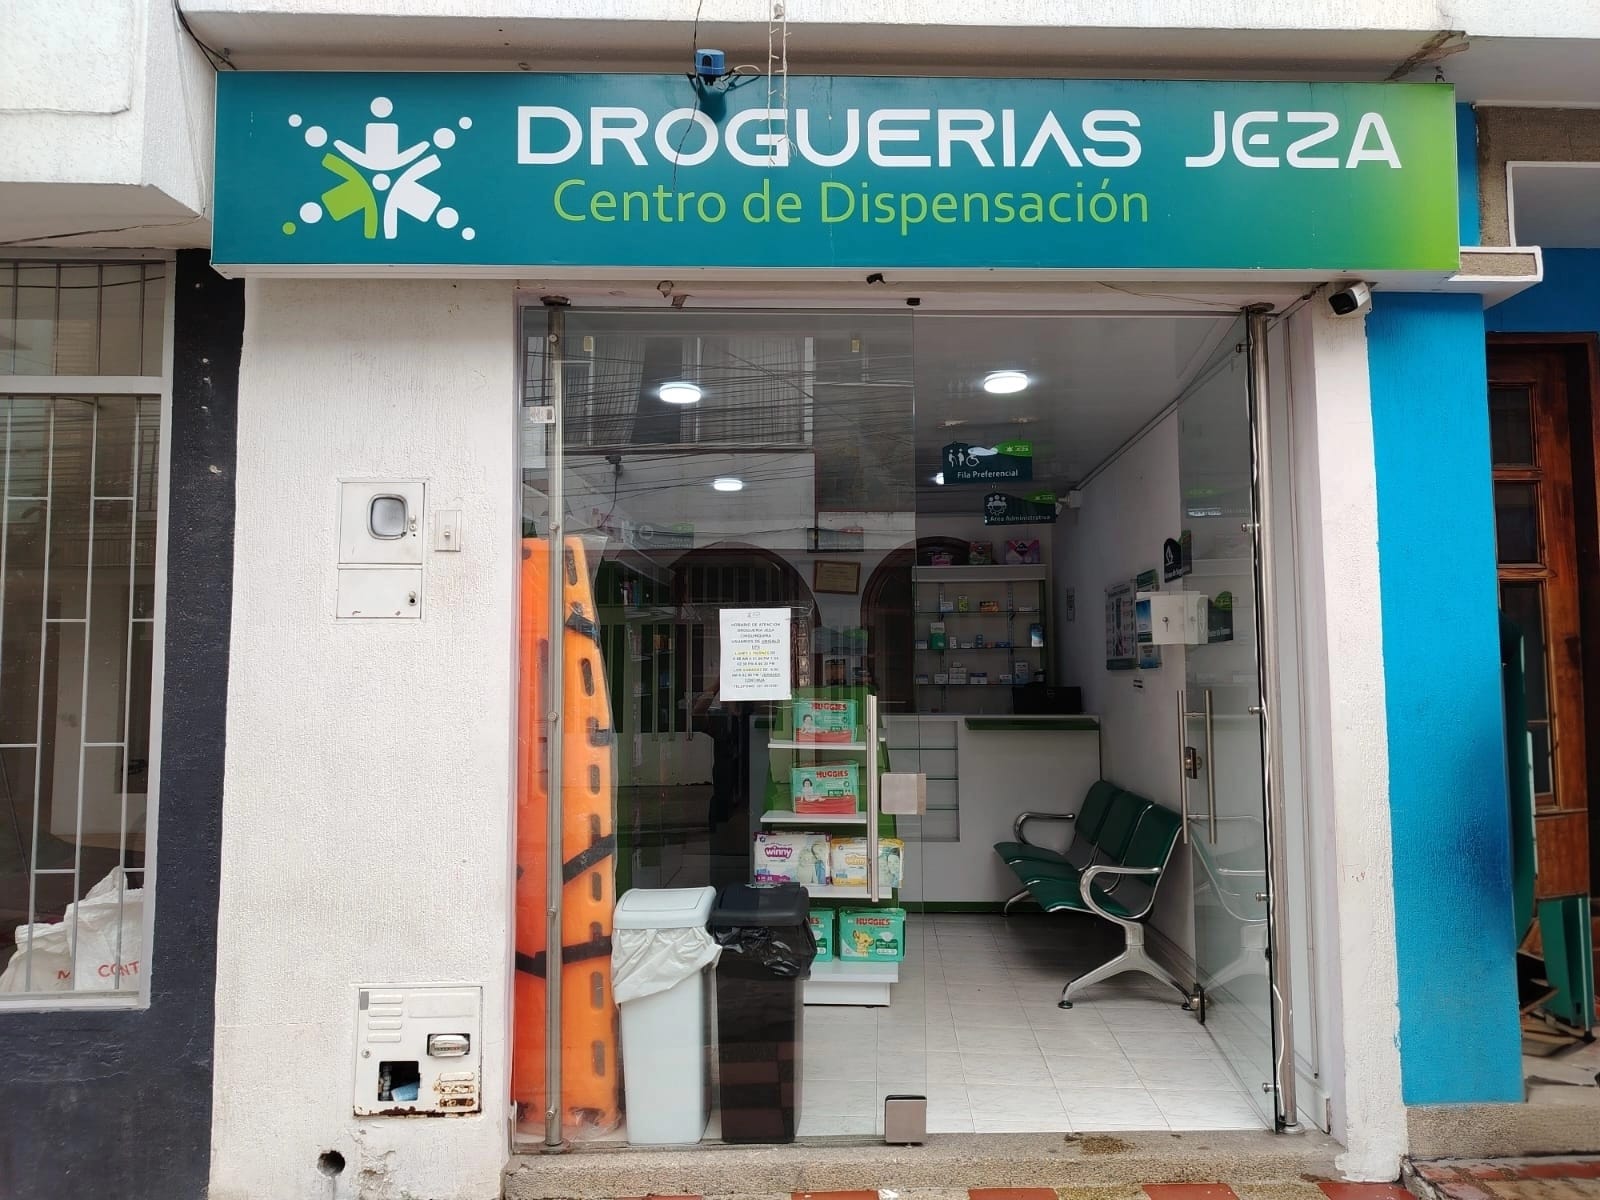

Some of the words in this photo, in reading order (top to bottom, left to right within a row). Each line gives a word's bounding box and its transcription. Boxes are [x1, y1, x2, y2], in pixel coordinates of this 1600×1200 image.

[517, 105, 1142, 168] DROGUERIAS
[1184, 109, 1403, 170] JEZA
[552, 178, 728, 224] Centro
[741, 177, 803, 224] de
[818, 176, 1150, 237] Dispensación
[972, 469, 1018, 478] Preferencial
[811, 702, 848, 711] HUGGIES
[815, 769, 849, 780] HUGGIES
[765, 845, 793, 859] winny
[855, 917, 891, 926] HUGGIES
